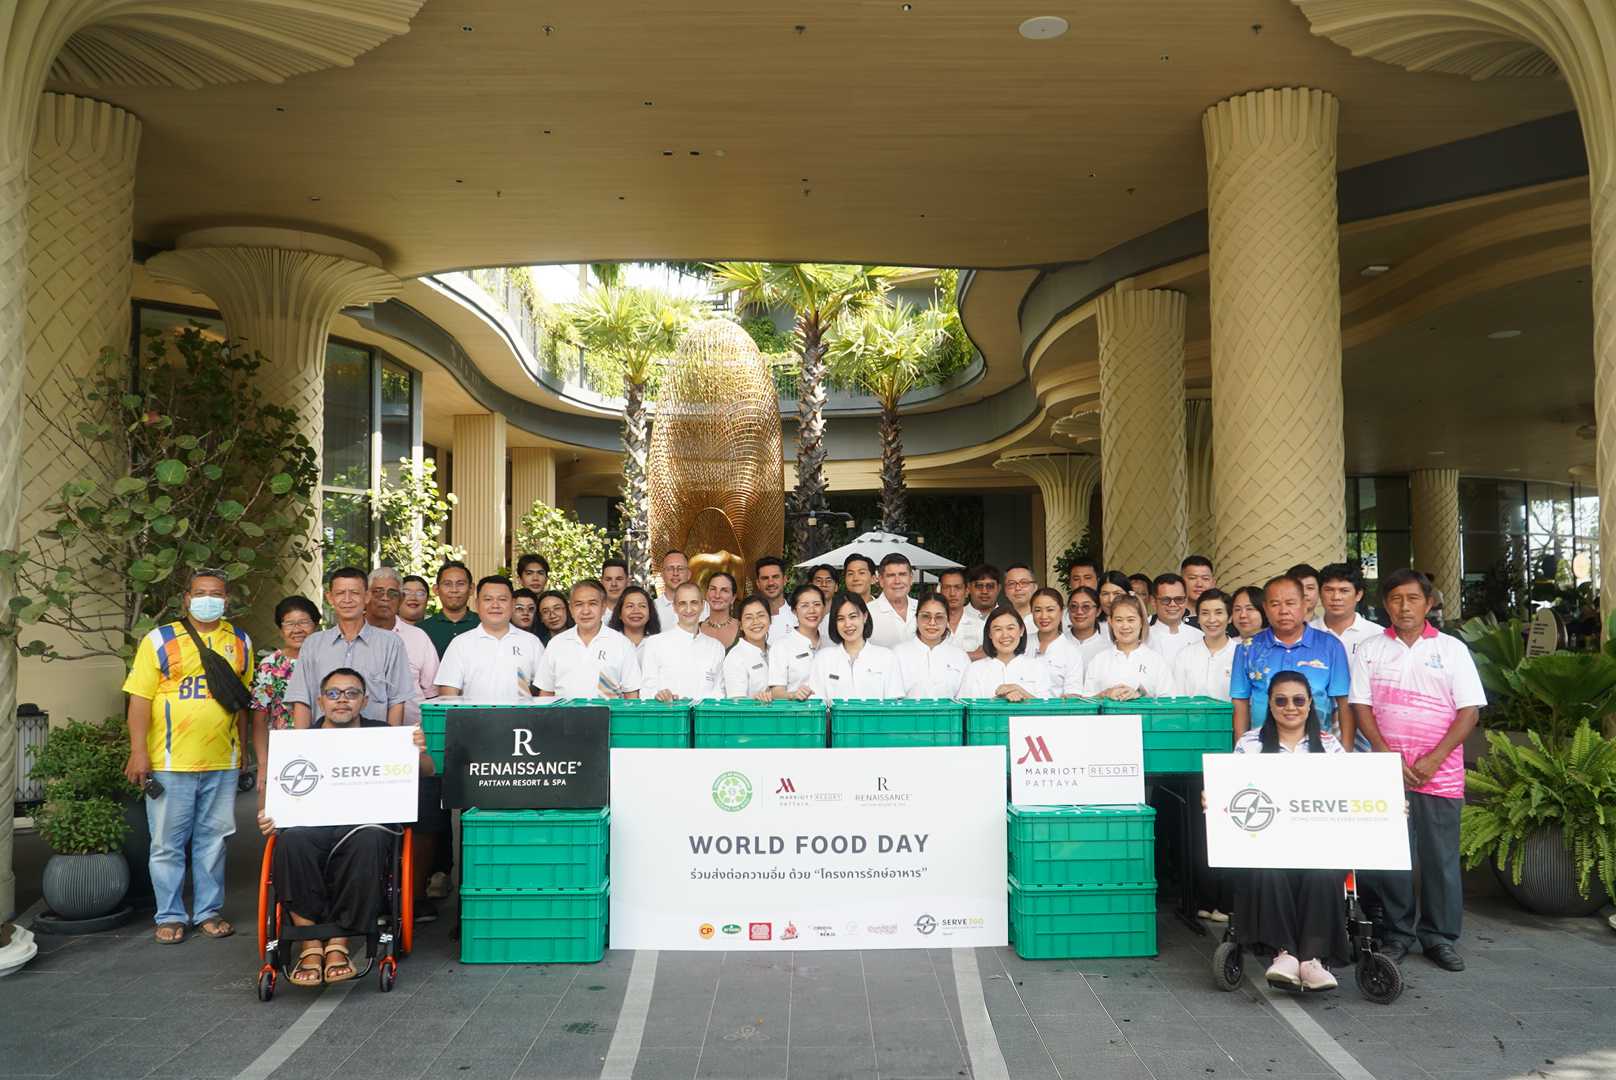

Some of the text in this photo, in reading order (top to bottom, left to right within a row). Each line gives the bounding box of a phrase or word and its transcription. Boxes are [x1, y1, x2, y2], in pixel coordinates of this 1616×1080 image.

[512, 646, 522, 656] R
[597, 650, 607, 660] R
[1138, 664, 1147, 674] R
[511, 728, 541, 756] R
[331, 764, 413, 778] SERVE 360
[1025, 766, 1137, 775] MARRIOTT RESORT
[478, 779, 511, 787] PATTAYA
[877, 777, 890, 791] R
[1289, 799, 1388, 813] SERVE 360
[689, 834, 929, 855] WORLD FOOD DAY
[690, 867, 928, 880] ร่วมส่งต่อความอิ่ม ด้วย “โครงการรักษ์อาหาร”
[700, 927, 713, 935] CP
